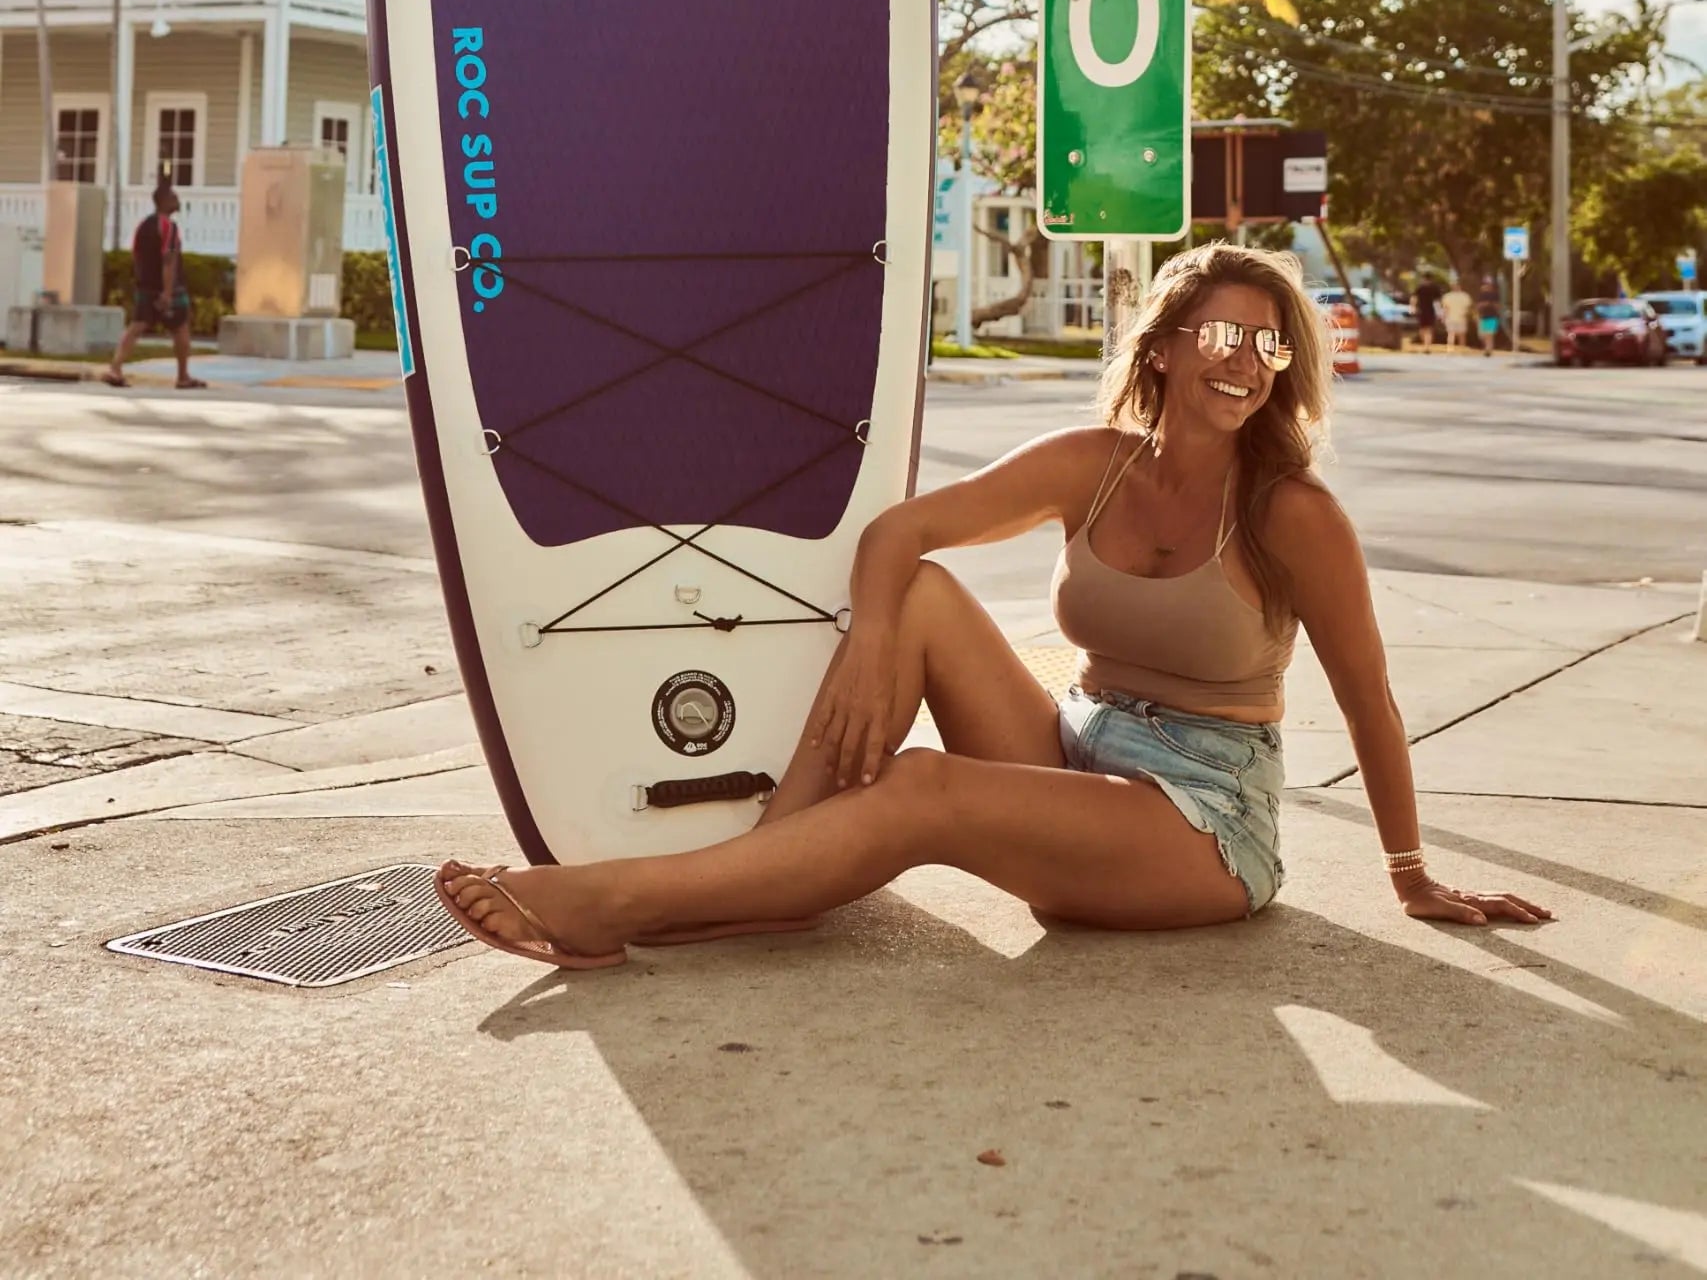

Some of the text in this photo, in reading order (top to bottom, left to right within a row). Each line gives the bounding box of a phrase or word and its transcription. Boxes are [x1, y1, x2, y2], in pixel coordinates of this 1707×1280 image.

[452, 26, 505, 313] ROC SUP CO.
